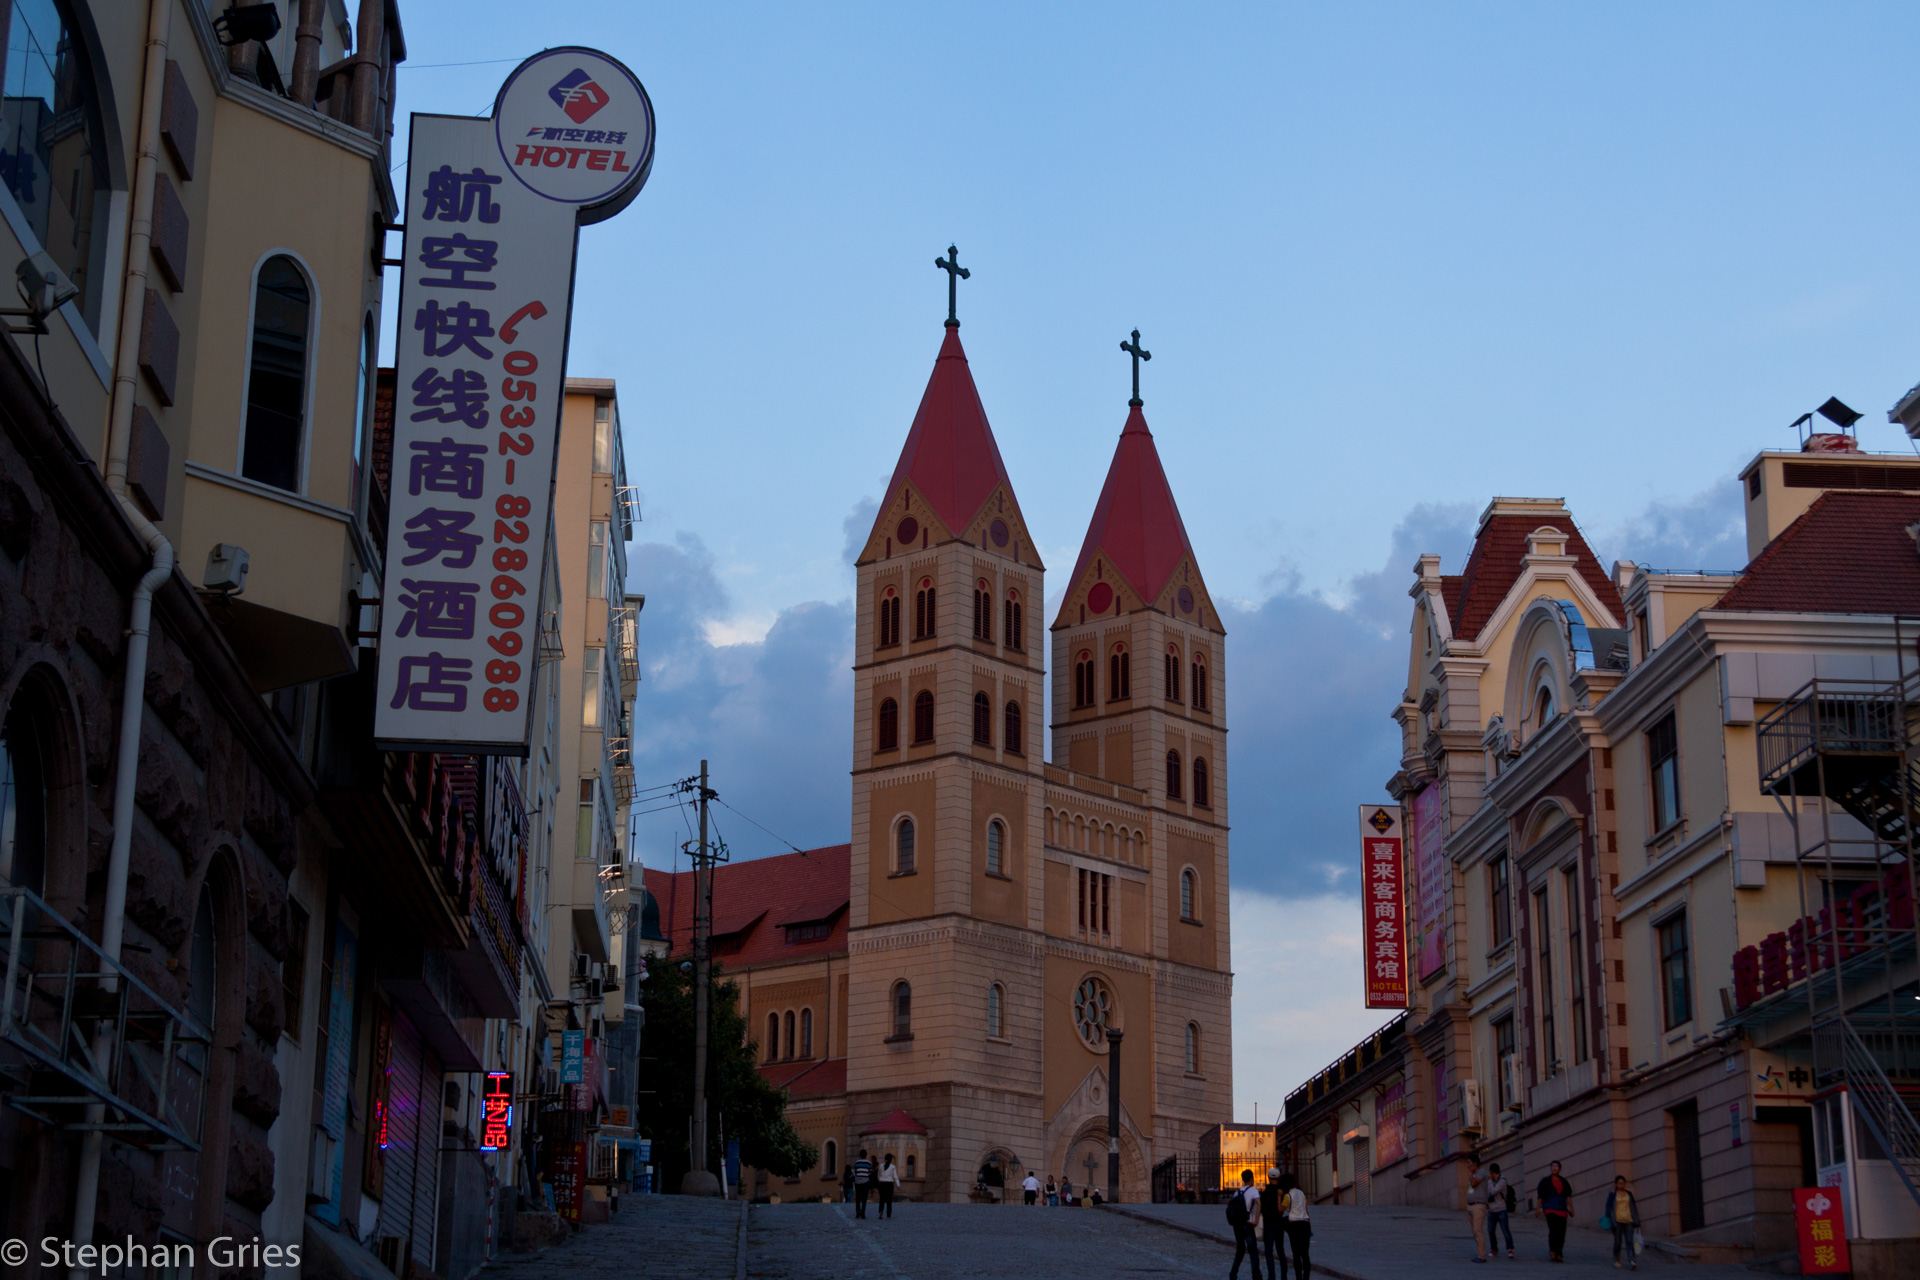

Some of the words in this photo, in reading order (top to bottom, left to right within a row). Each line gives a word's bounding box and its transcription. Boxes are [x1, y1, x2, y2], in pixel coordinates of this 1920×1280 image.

[514, 144, 630, 172] HOTEL
[541, 127, 628, 145] 航空快线
[390, 165, 503, 712] 航空快线商务酒店
[483, 350, 539, 713] 0532-82860988
[1371, 841, 1400, 979] 喜来客商务宾馆
[1372, 982, 1404, 991] HOTEL
[564, 1034, 581, 1081] 干海产品
[484, 1074, 510, 1147] 工艺品
[1810, 1218, 1838, 1267] 福彩
